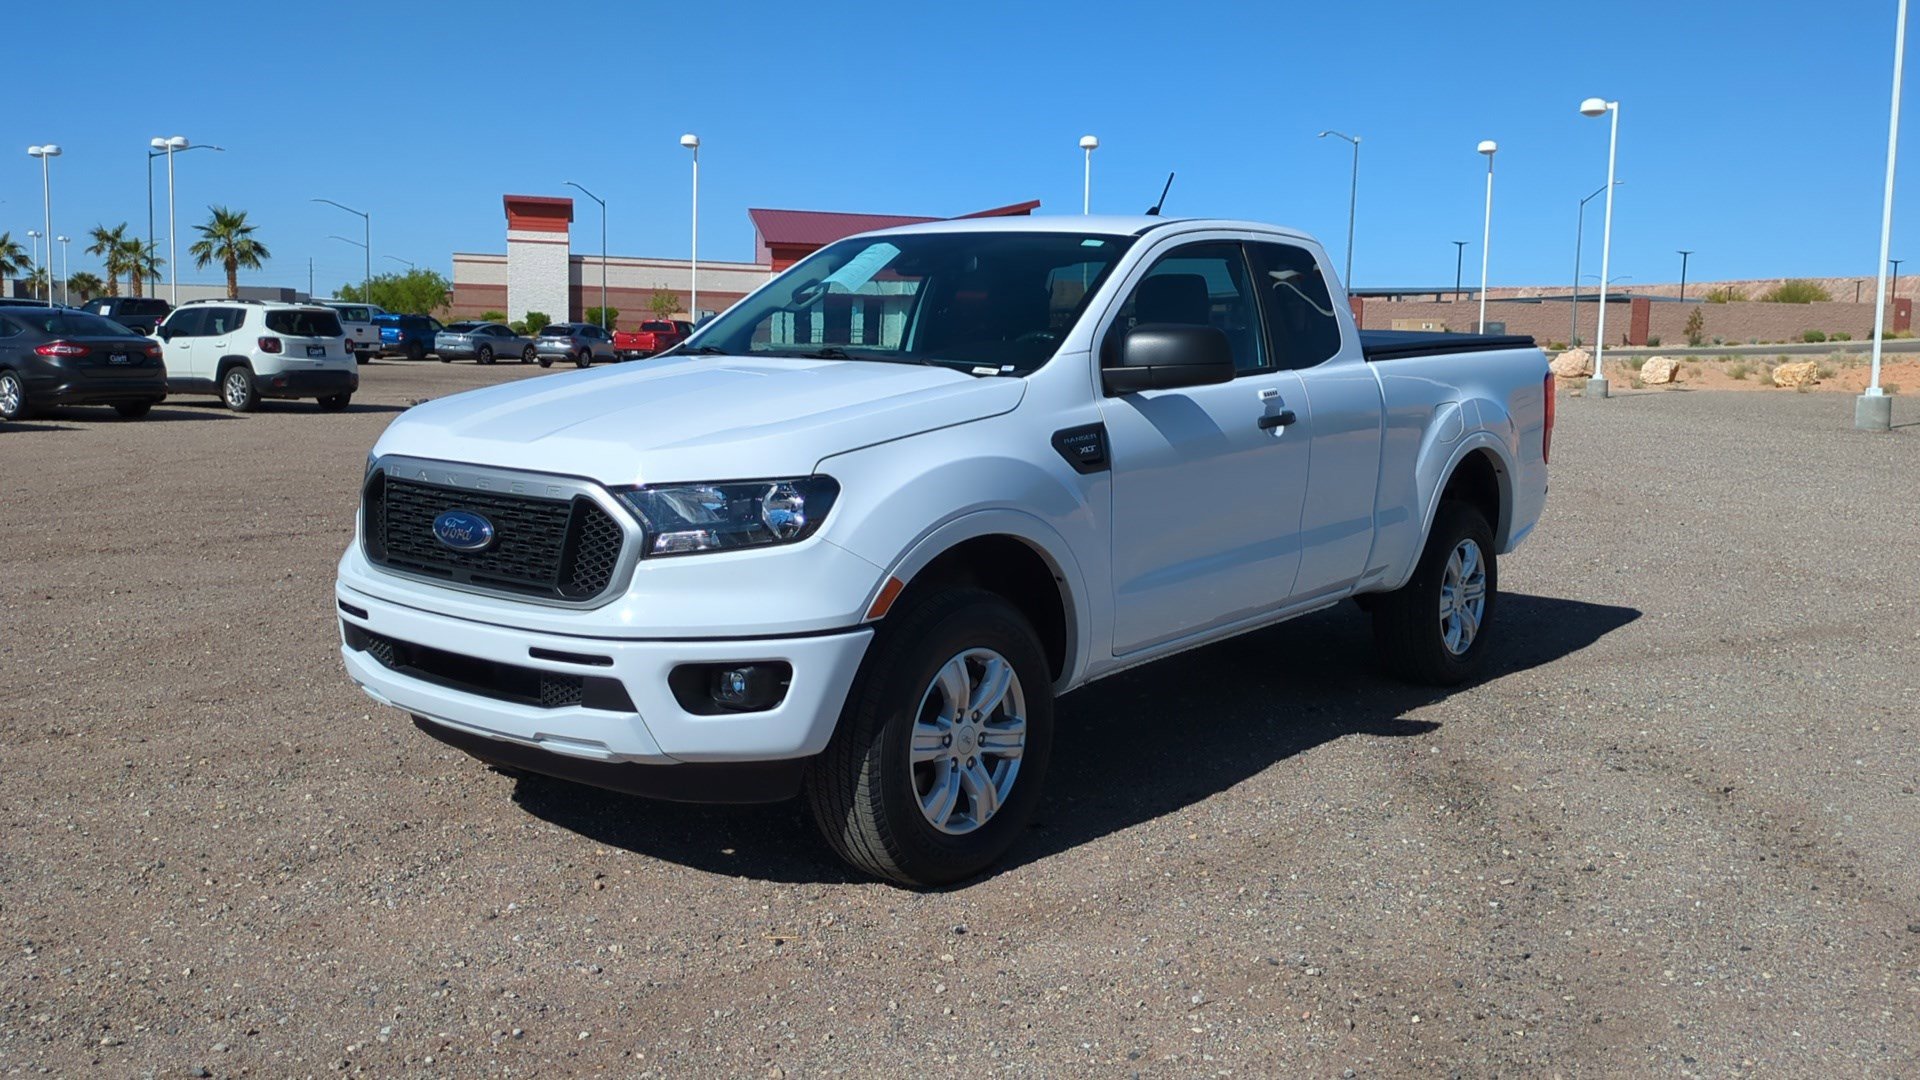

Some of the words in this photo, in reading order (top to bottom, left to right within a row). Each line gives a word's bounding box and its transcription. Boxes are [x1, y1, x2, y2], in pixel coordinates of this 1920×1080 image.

[1080, 445, 1096, 454] XLT
[389, 465, 562, 496] RANGER
[440, 517, 474, 541] Ford
